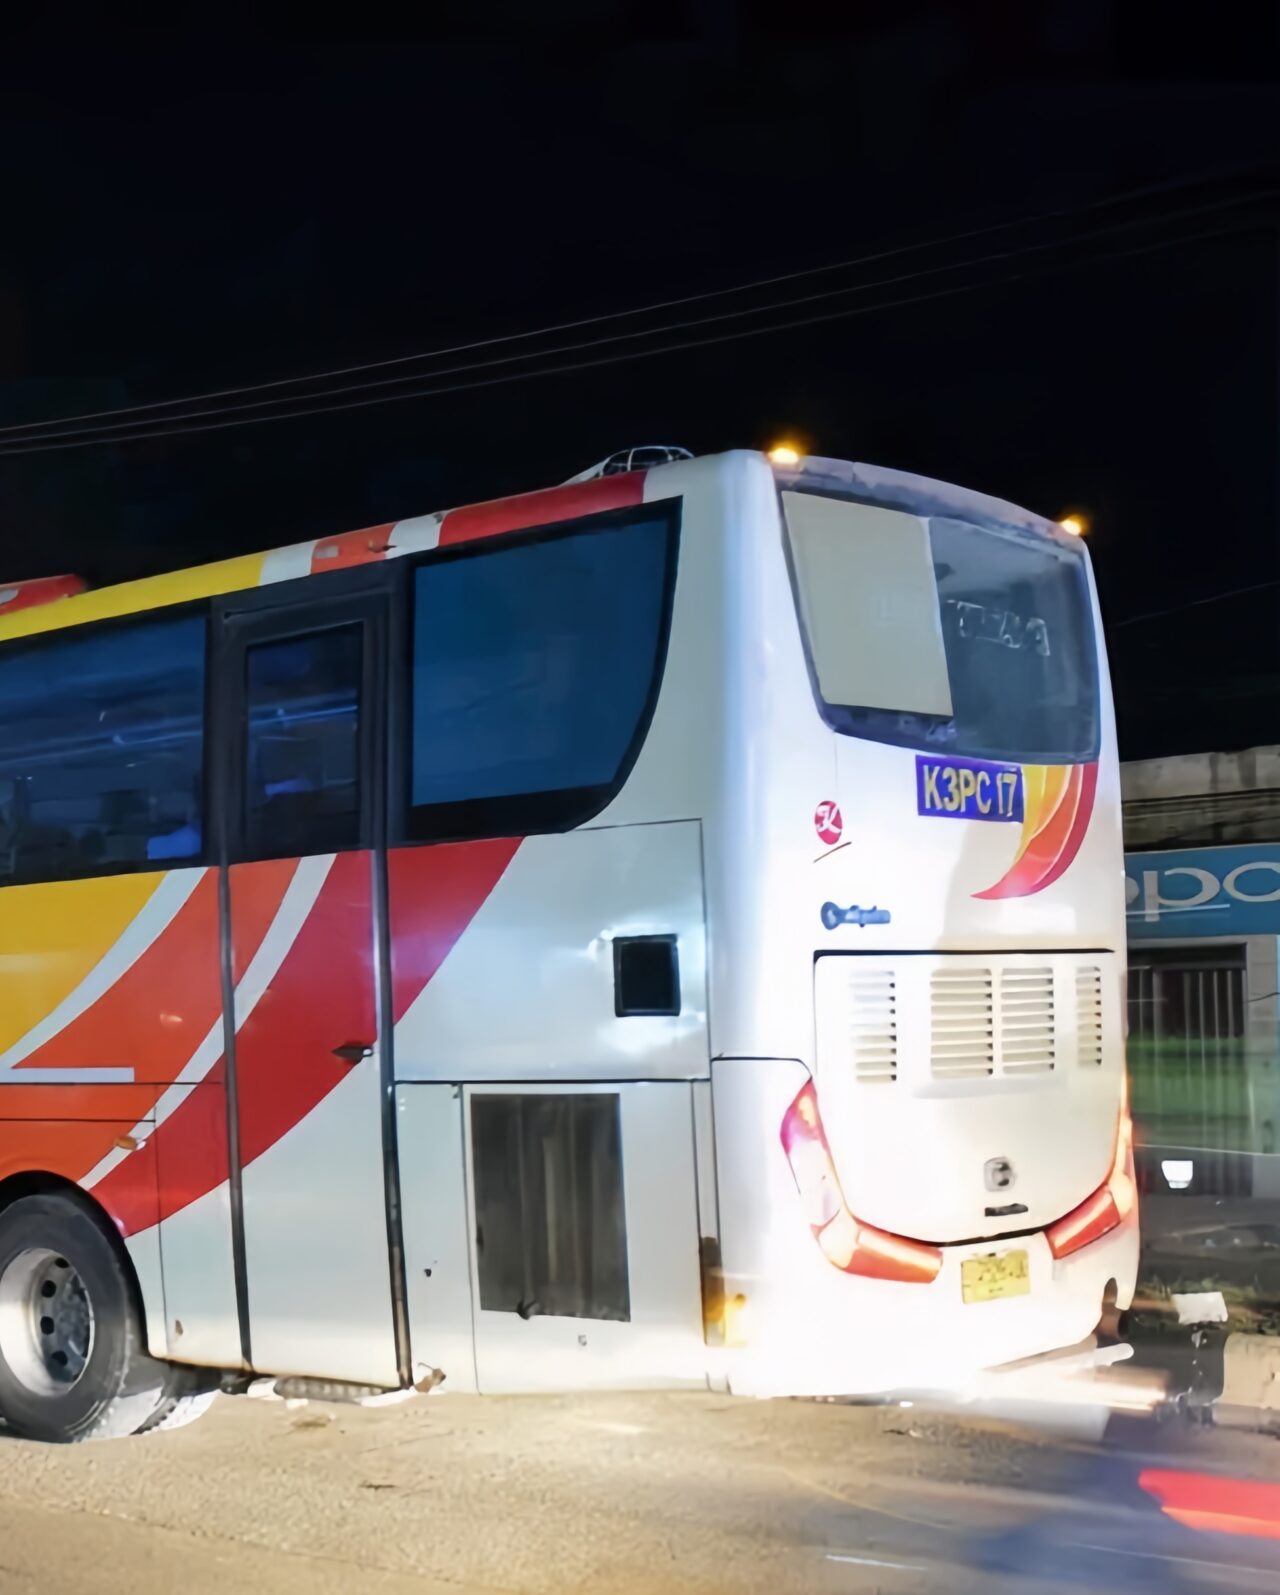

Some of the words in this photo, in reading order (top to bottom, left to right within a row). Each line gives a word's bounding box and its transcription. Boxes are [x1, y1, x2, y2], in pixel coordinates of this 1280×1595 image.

[923, 764, 992, 814] K3PC
[996, 771, 1018, 817] 17
[1125, 861, 1280, 922] po
